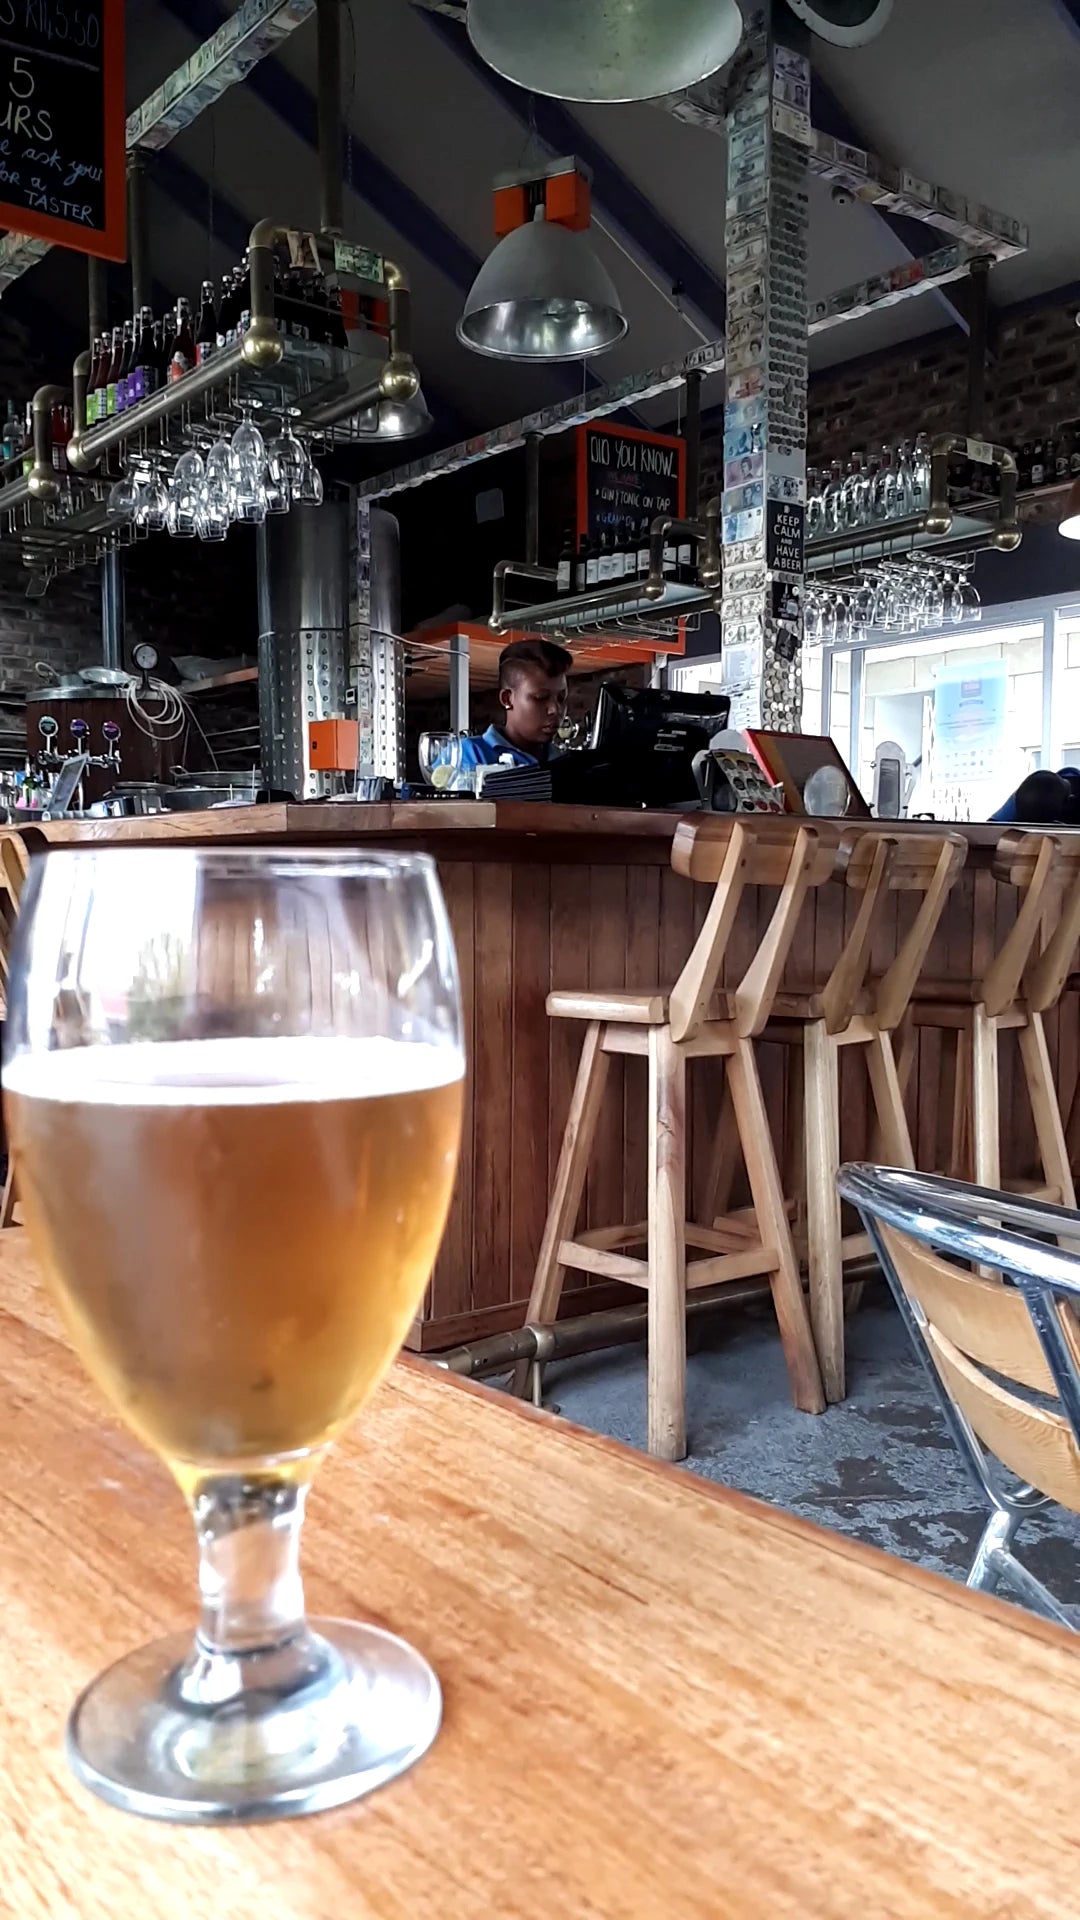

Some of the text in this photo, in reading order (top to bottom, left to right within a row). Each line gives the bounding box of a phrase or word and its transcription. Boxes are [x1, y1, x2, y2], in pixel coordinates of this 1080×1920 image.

[8, 56, 35, 98] 5
[21, 147, 63, 172] ask
[24, 189, 95, 228] TASTER
[590, 435, 610, 465] DID
[642, 496, 654, 509] ON
[656, 496, 671, 511] TAP
[776, 513, 800, 527] KEEP
[773, 524, 801, 539] CALM
[776, 544, 800, 559] HAVE
[773, 556, 801, 571] A BEER
